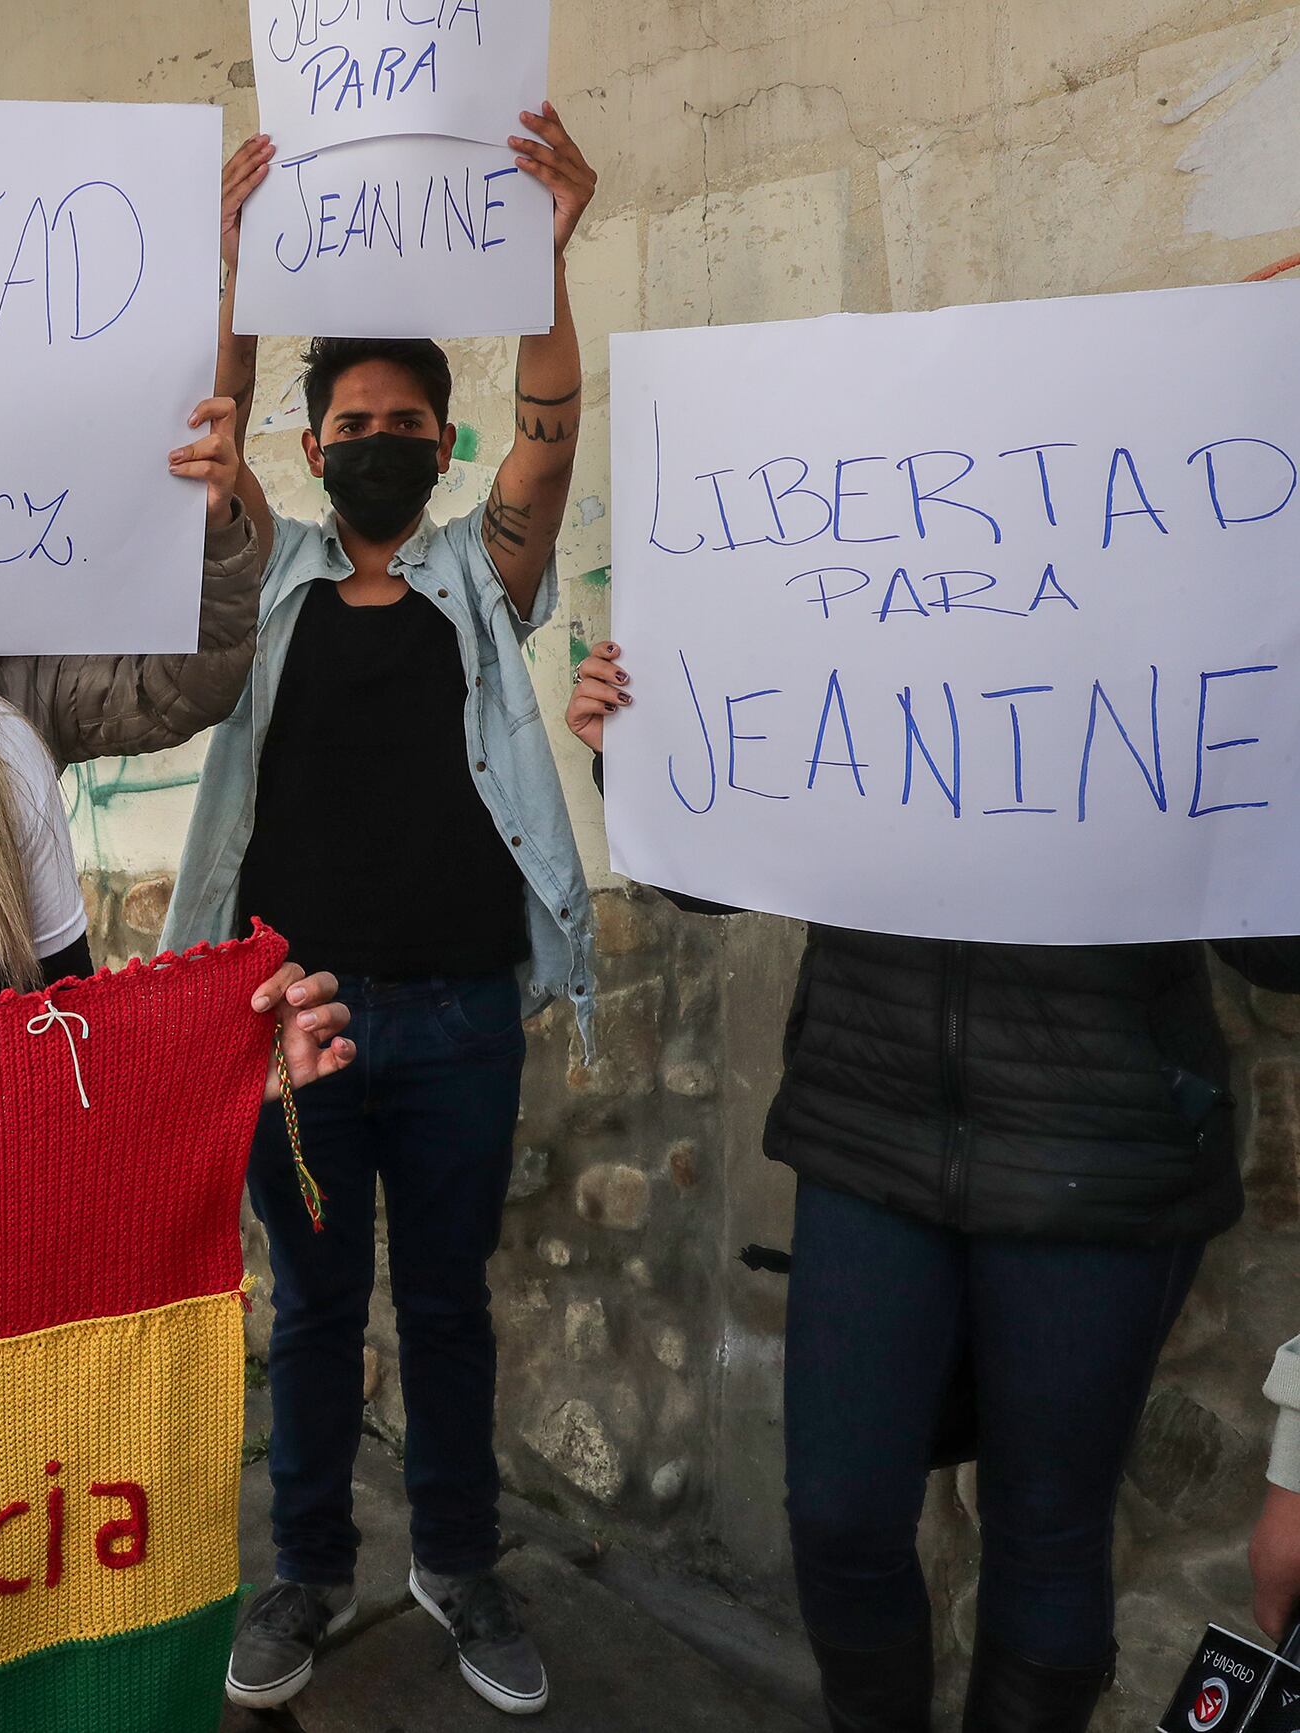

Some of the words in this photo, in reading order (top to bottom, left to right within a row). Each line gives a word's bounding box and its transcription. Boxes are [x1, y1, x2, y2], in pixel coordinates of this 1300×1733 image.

[300, 41, 436, 115] PARA
[275, 154, 519, 272] JEANINE
[649, 400, 1298, 554] LIBERTAD
[786, 564, 1079, 623] PARA
[668, 649, 1279, 823] JEANINE
[1212, 1652, 1255, 1684] CADENA
